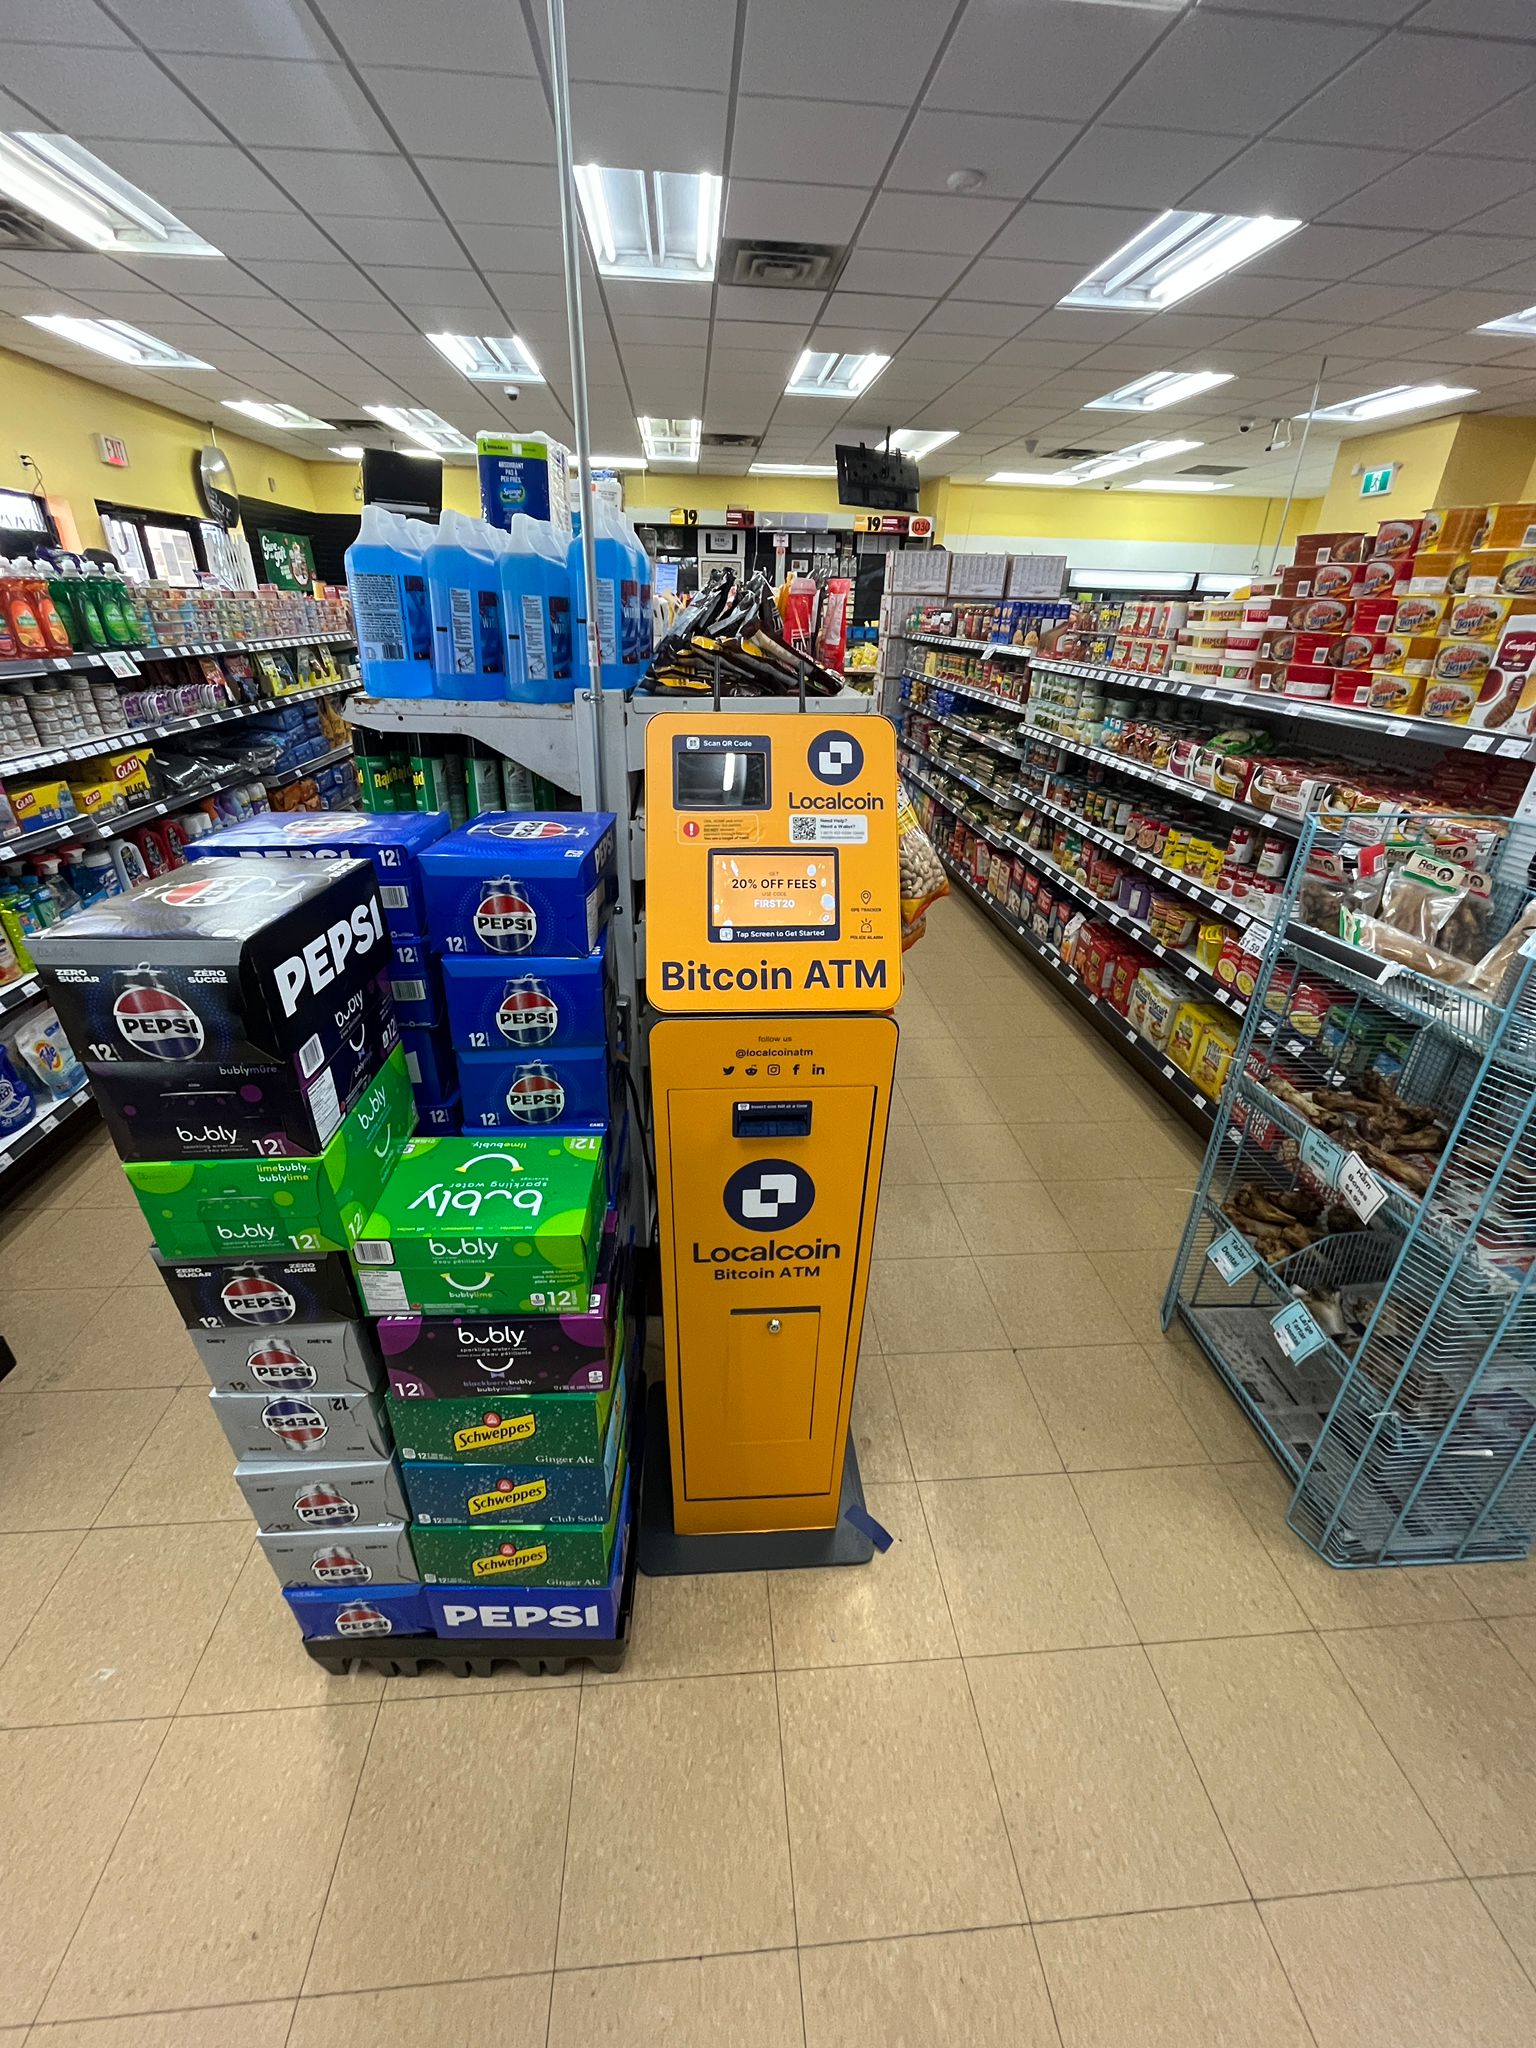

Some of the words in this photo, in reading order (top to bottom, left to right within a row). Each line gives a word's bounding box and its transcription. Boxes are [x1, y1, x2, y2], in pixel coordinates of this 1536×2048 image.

[104, 437, 124, 460] EXIT
[683, 509, 698, 525] 19
[867, 516, 880, 531] 19
[116, 758, 138, 779] GLAD
[125, 781, 146, 793] BLACK
[16, 794, 34, 810] GLAD
[85, 790, 100, 805] GLAD
[788, 792, 884, 810] Localcoin
[378, 850, 397, 867] 12
[594, 831, 613, 874] PEPSI
[1386, 849, 1405, 859] Rex
[1434, 847, 1452, 856] Rex
[1418, 859, 1438, 872] Rex
[732, 879, 757, 889] 20%
[761, 879, 783, 889] OFF
[787, 879, 817, 889] FEES
[754, 900, 795, 908] FIRST20
[478, 918, 532, 931] PEPSI
[446, 937, 463, 953] 12
[1240, 938, 1260, 953] $1.59
[274, 895, 384, 1018] PEPSI
[397, 947, 415, 963] 12
[55, 969, 88, 978] ZERO
[58, 975, 100, 983] SUGAR
[188, 976, 228, 984] SUCRE
[662, 960, 792, 991] Bitcoin
[804, 960, 886, 988] ATM
[500, 1012, 554, 1024] PEPSI
[122, 1018, 198, 1034] PEPSI
[468, 1033, 485, 1047] 12
[88, 1044, 117, 1061] 12
[736, 1048, 813, 1058] @localcoinatm
[219, 1064, 277, 1076] bublymûre
[358, 1086, 386, 1129] bubly
[510, 1094, 561, 1106] PEPSI
[430, 1110, 445, 1123] 12
[480, 1113, 496, 1126] 12
[176, 1125, 237, 1145] bubly
[252, 1139, 280, 1155] 12
[472, 1141, 527, 1150] limebubly
[576, 1138, 596, 1150] 12
[256, 1163, 307, 1173] limebubly
[258, 1174, 309, 1183] bublylime
[1356, 1169, 1371, 1190] Ham
[1347, 1174, 1367, 1201] Bones
[407, 1183, 543, 1217] bubly
[348, 1212, 362, 1236] 12
[216, 1224, 274, 1240] bubly
[289, 1235, 315, 1250] 12
[428, 1238, 498, 1260] bubly
[1231, 1239, 1247, 1260] Tartar
[693, 1238, 841, 1263] Localcoin
[1221, 1246, 1239, 1267] Dental
[714, 1268, 774, 1281] Bitcoin
[779, 1266, 820, 1278] ATM
[449, 1291, 493, 1299] bublylime
[547, 1290, 571, 1306] 12
[230, 1296, 291, 1310] PEPSI
[199, 1317, 220, 1328] 12
[1292, 1319, 1306, 1339] Tartar
[1298, 1314, 1314, 1335] Large
[458, 1326, 524, 1347] bubly
[1284, 1323, 1300, 1345] Dental
[257, 1367, 312, 1377] PEPSI
[229, 1381, 246, 1390] 12
[395, 1383, 419, 1396] 12
[463, 1379, 533, 1387] blackberrybubly
[331, 1398, 350, 1411] 12
[267, 1417, 320, 1427] PEPSI
[458, 1422, 532, 1447] Schweppes
[535, 1455, 575, 1464] Ginger
[473, 1488, 542, 1511] Schweppes
[302, 1505, 354, 1517] PEPSI
[550, 1515, 575, 1523] Club
[476, 1551, 543, 1573] Schweppes
[319, 1567, 368, 1577] PEPSI
[443, 1605, 599, 1627] PEPSI
[340, 1620, 388, 1630] PEPSI
